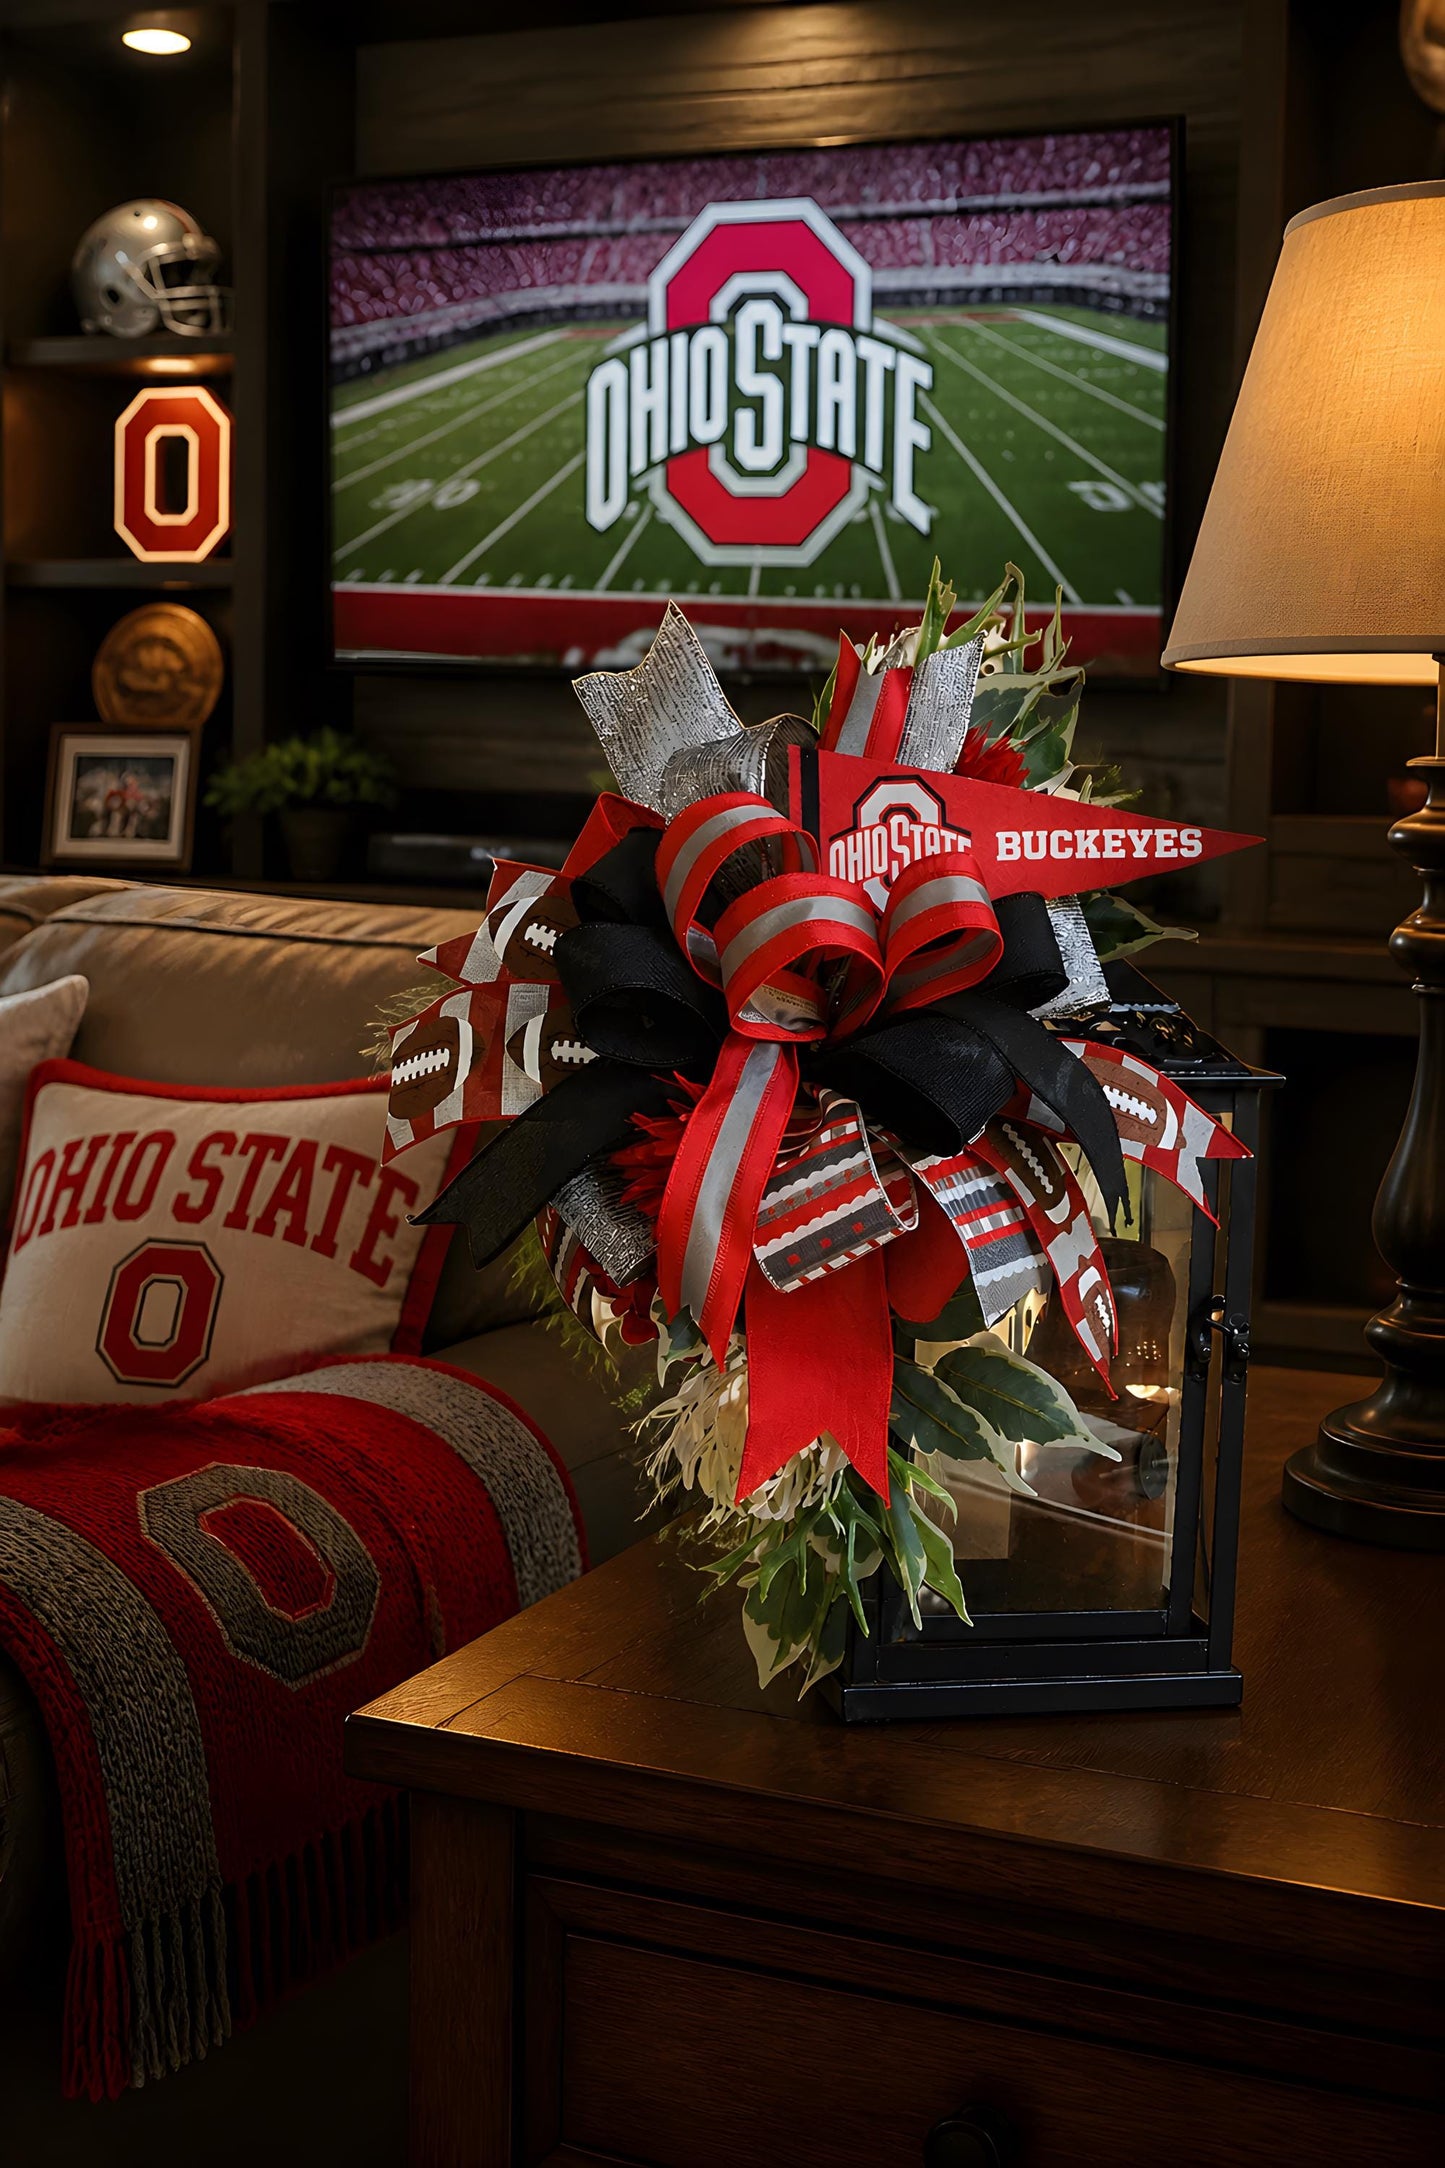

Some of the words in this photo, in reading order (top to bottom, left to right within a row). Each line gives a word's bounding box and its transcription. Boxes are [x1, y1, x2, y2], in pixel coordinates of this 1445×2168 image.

[586, 325, 728, 532] OHIO
[732, 298, 935, 535] STATE
[829, 825, 888, 884] OHIO
[889, 814, 973, 882] STAT
[996, 828, 1204, 862] BUCKEYES
[13, 1129, 176, 1255] OHIO
[171, 1130, 421, 1289] STATE
[95, 1237, 225, 1389] O
